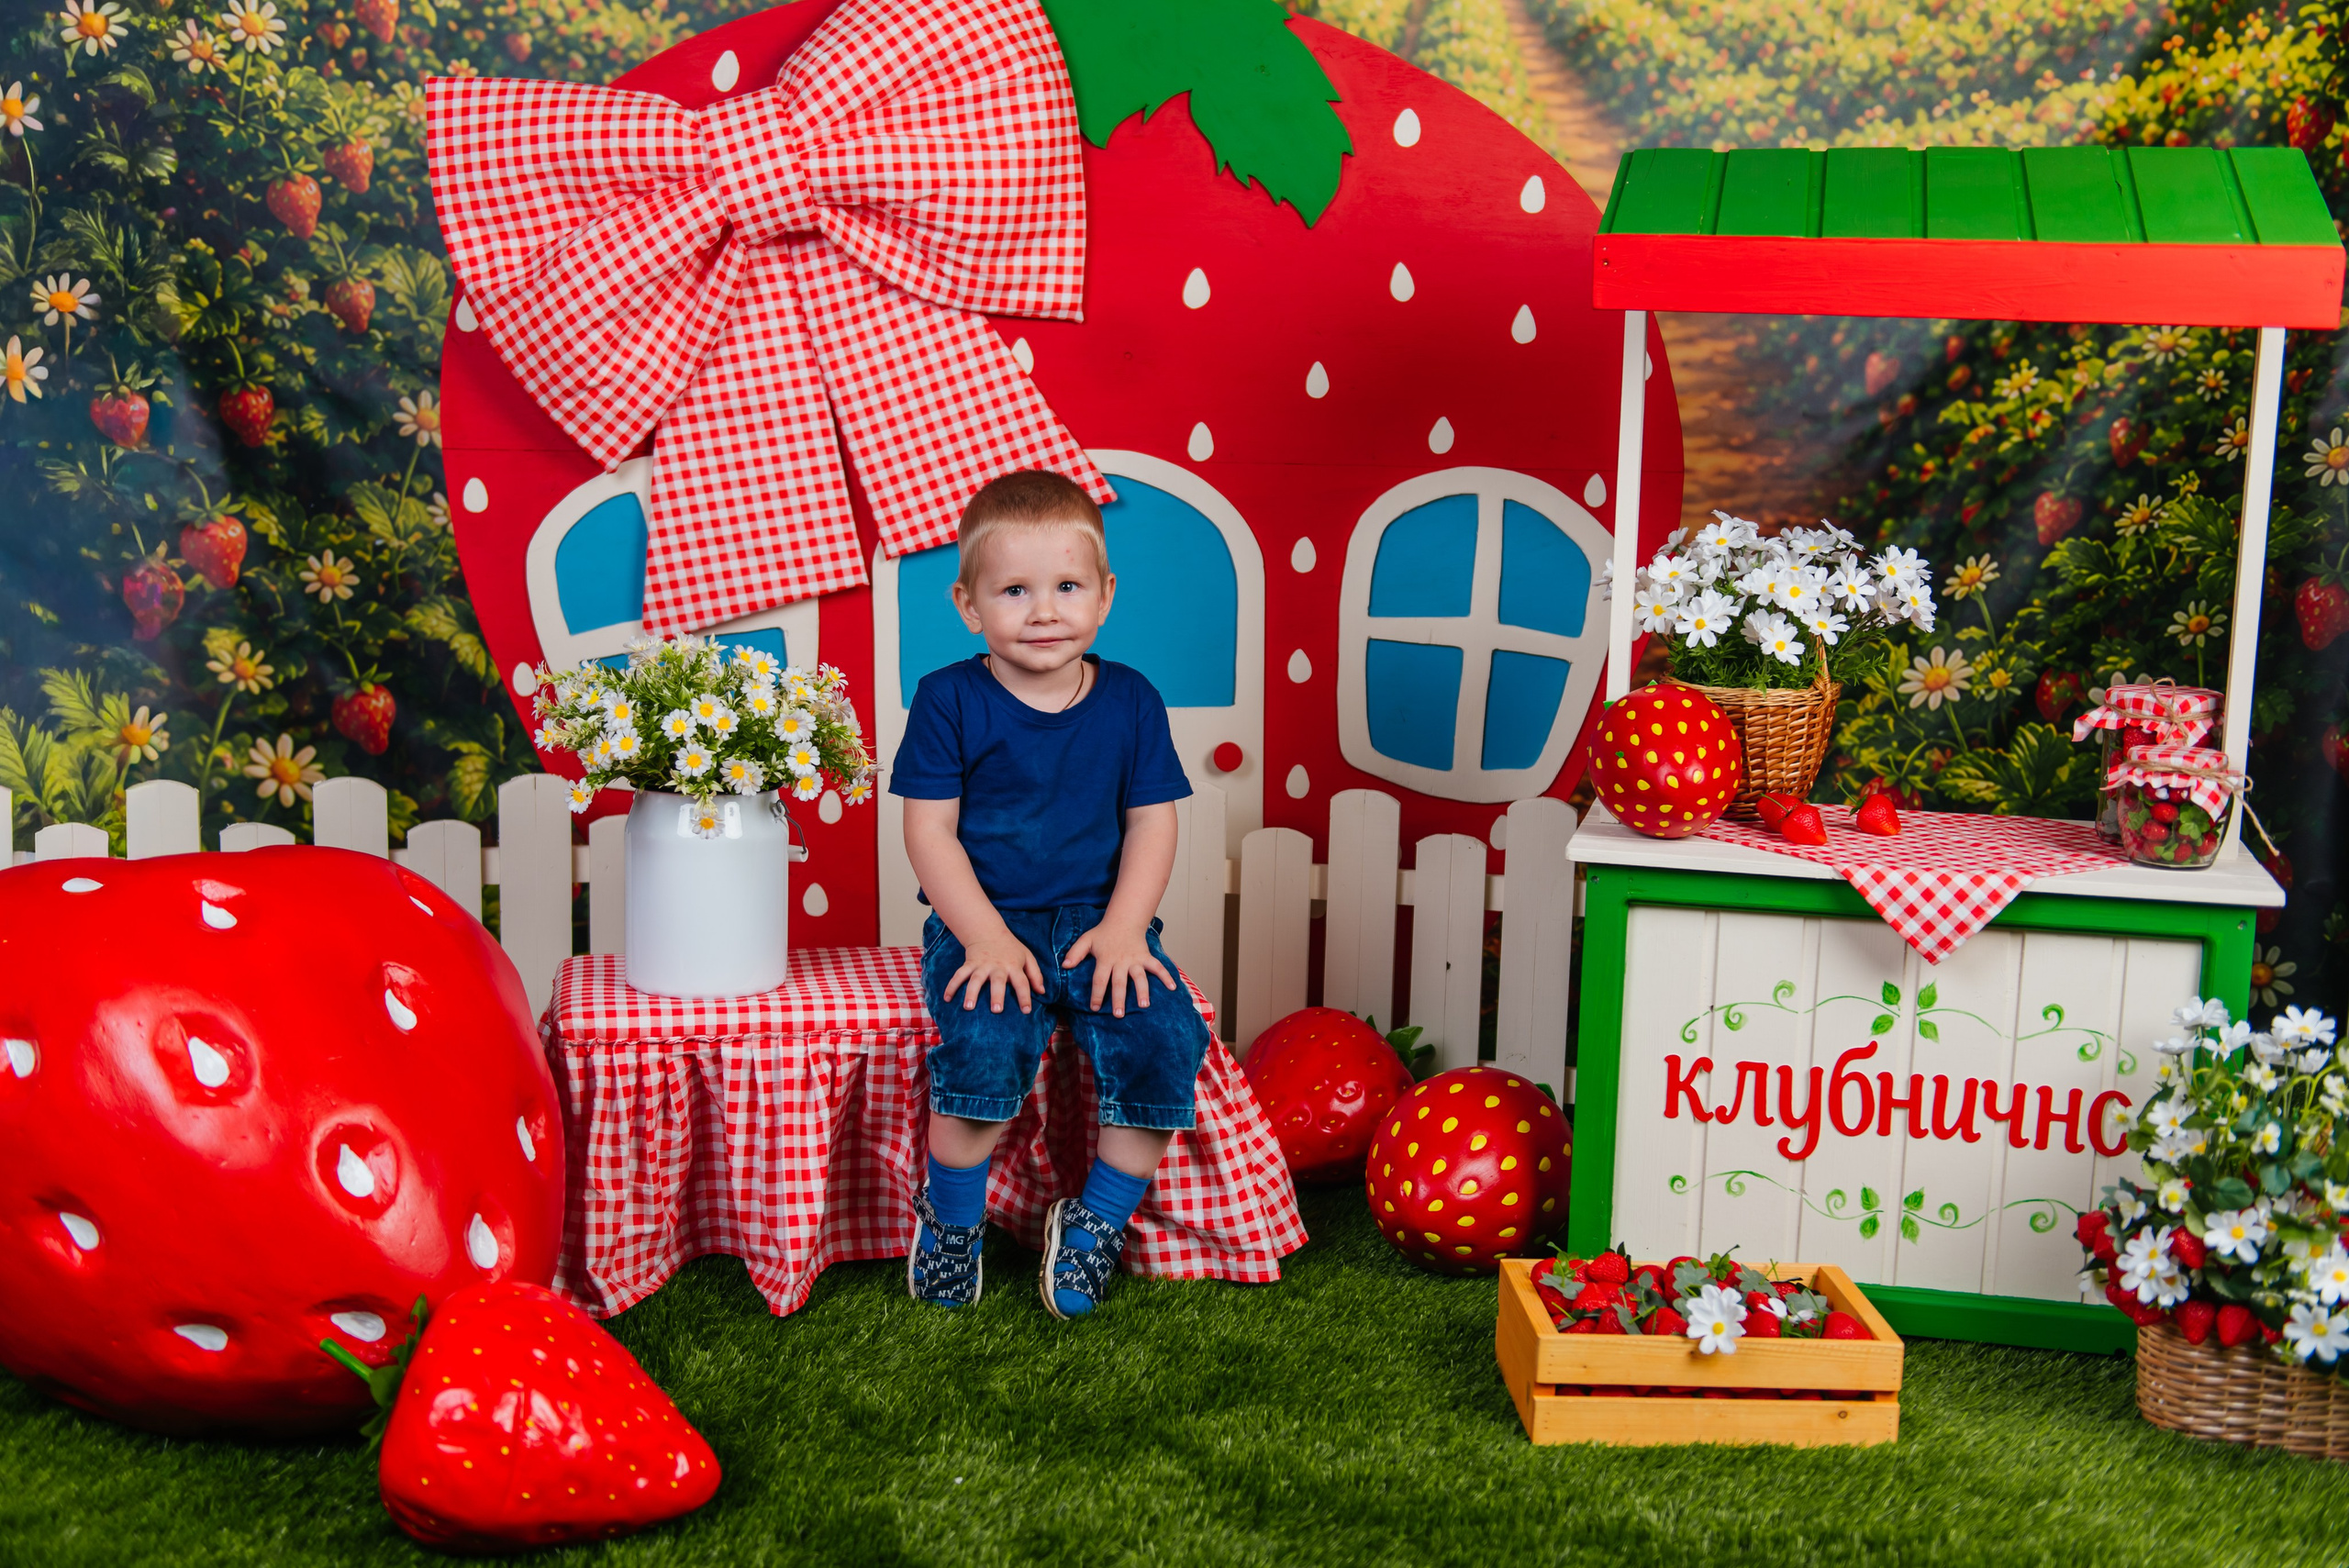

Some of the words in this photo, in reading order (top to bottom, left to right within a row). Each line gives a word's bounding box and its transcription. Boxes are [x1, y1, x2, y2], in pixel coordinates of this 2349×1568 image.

[1078, 1208, 1094, 1220] NY
[1084, 1221, 1100, 1234] NY
[1101, 1221, 1116, 1235] NY
[946, 1234, 964, 1245] MG
[1111, 1236, 1124, 1251] MG
[1063, 1249, 1077, 1257] NY
[928, 1260, 941, 1270] NY
[1086, 1253, 1102, 1267] NY
[954, 1262, 969, 1273] NY
[1063, 1271, 1080, 1284] NY
[916, 1284, 927, 1296] NY
[938, 1289, 953, 1298] NY
